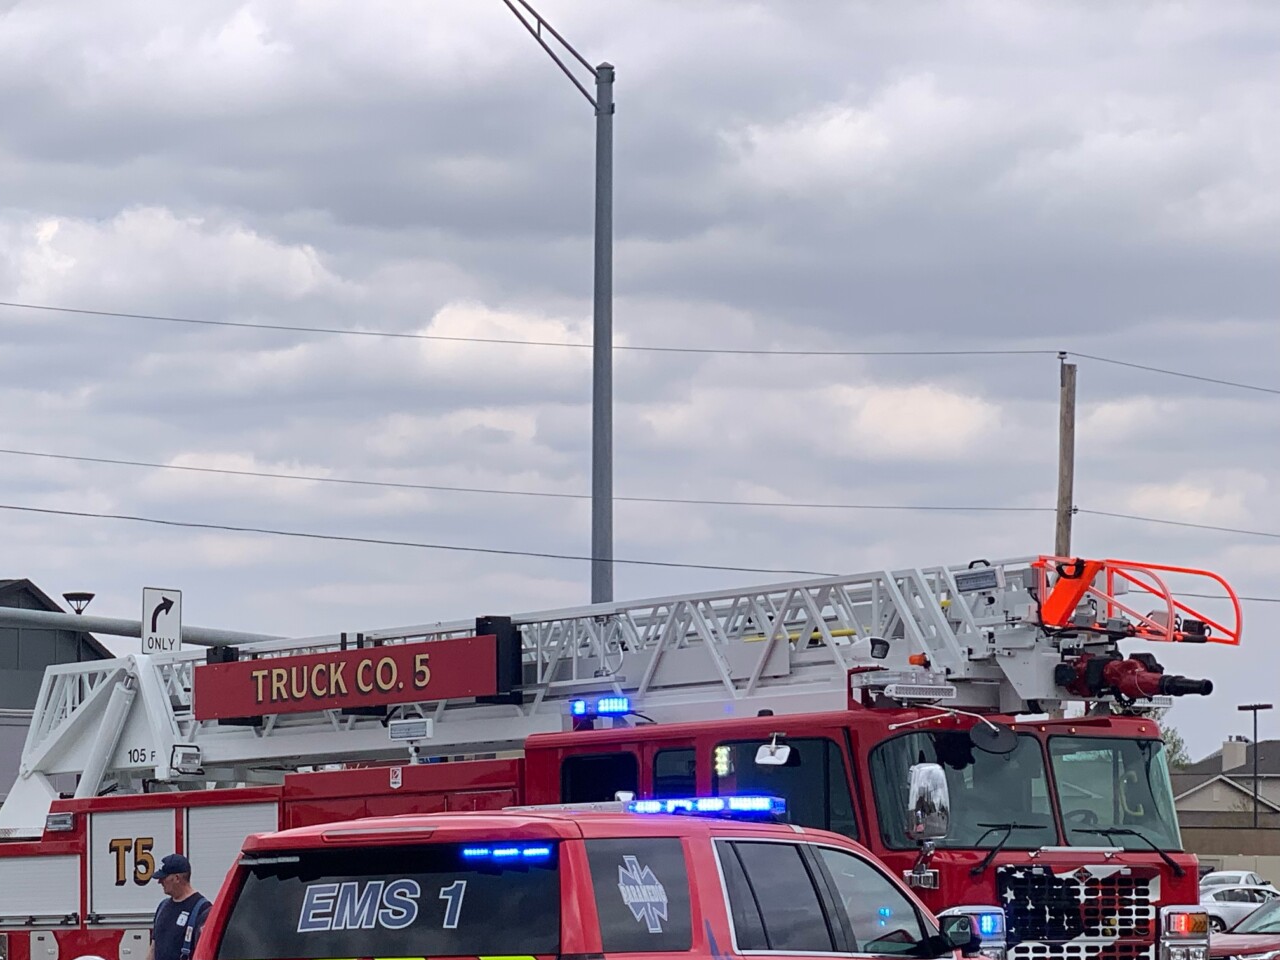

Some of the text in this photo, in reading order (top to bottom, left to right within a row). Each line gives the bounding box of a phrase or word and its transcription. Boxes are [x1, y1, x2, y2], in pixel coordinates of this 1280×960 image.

[148, 636, 175, 651] ONLY
[252, 653, 431, 703] TRUCK CO. 5
[128, 748, 156, 763] 105 F
[109, 837, 155, 886] T5
[297, 879, 467, 933] EMS 1
